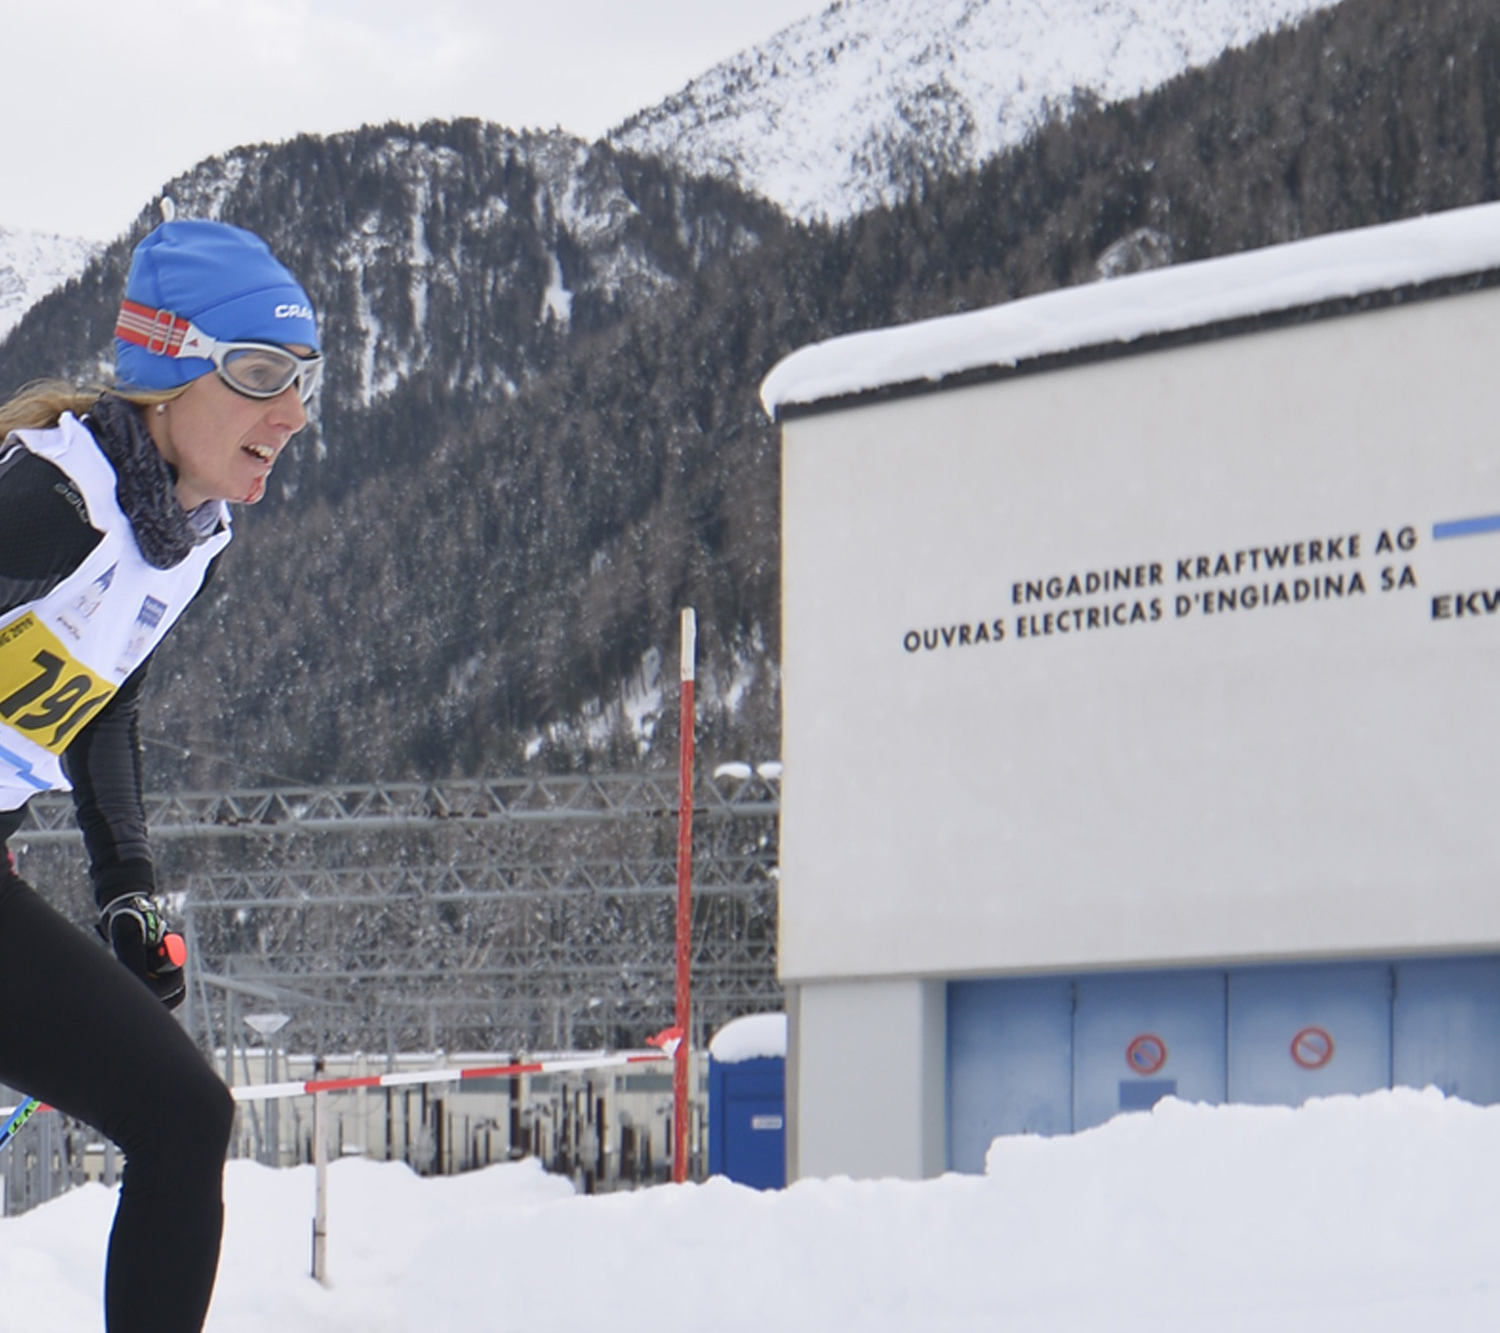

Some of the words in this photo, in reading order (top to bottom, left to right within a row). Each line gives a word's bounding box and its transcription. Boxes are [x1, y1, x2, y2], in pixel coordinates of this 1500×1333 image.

[1012, 563, 1164, 605] ENGADINER
[1176, 534, 1361, 582] KRAFTWERKE
[1375, 526, 1418, 555] AG
[903, 619, 1005, 653] OUVRAS
[1016, 597, 1163, 638] ELECTRICAS
[1175, 571, 1366, 617] D'ENGIADINA
[1381, 565, 1417, 592] SA
